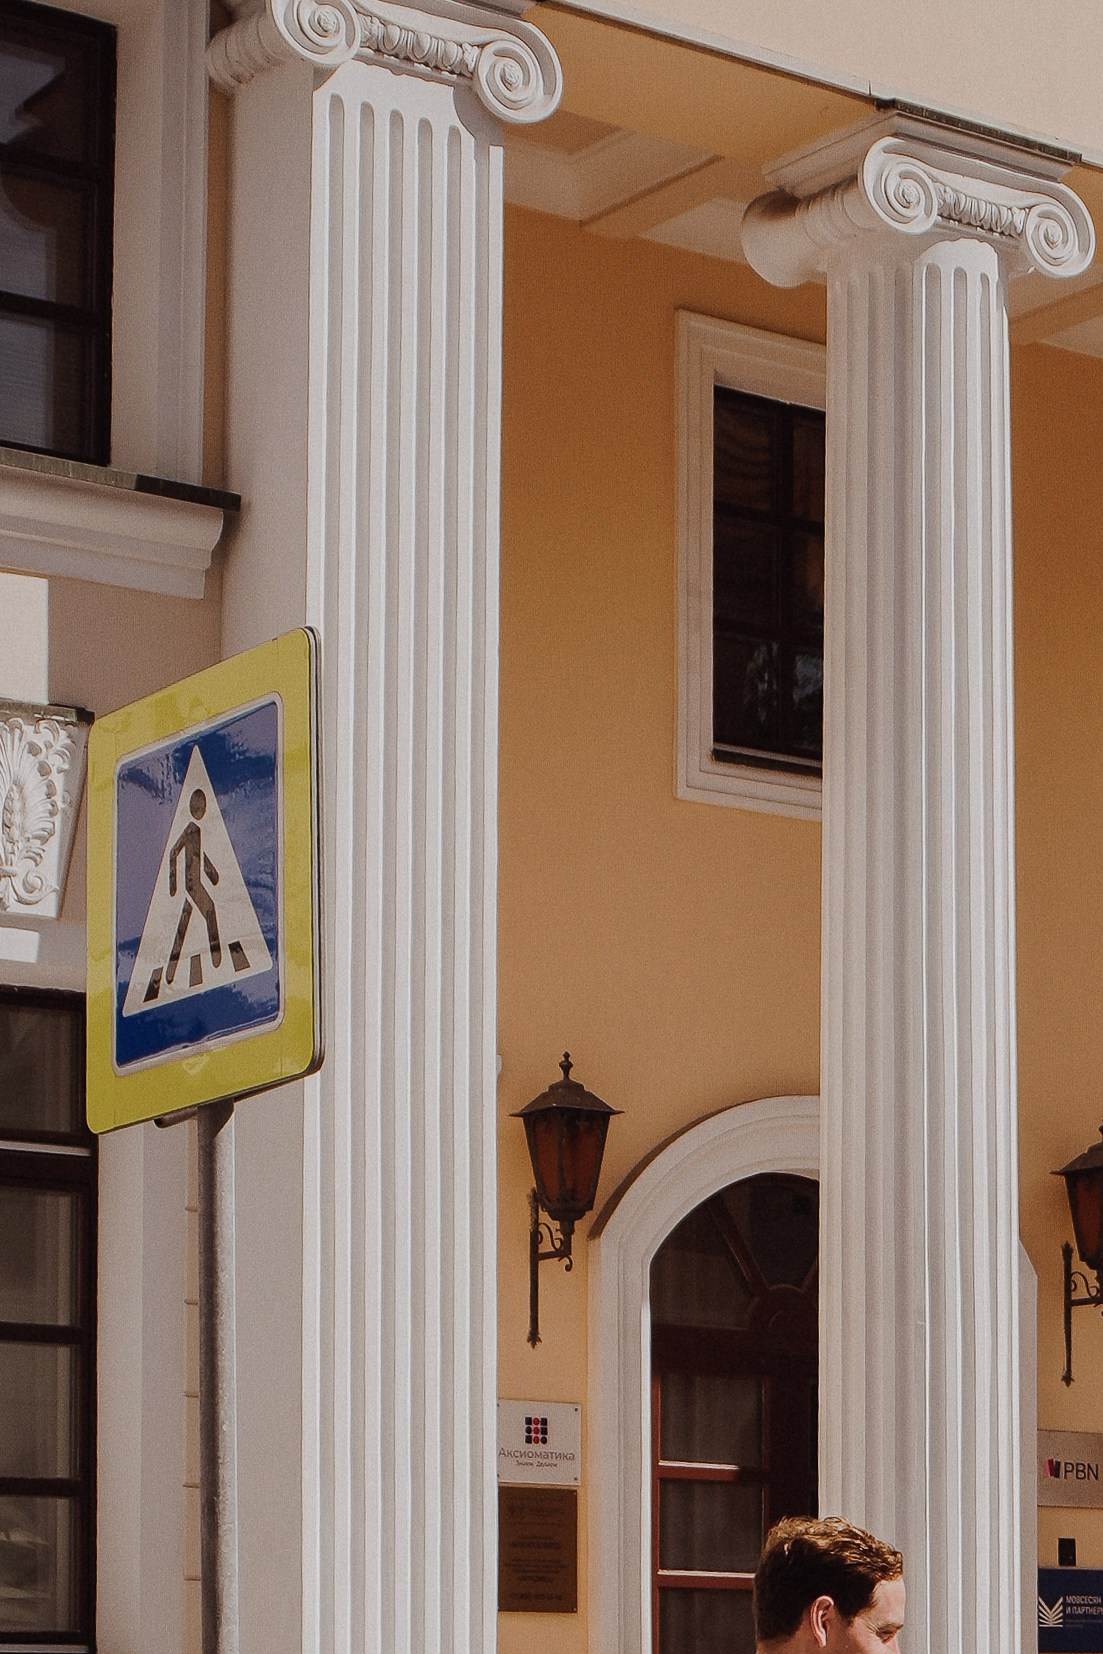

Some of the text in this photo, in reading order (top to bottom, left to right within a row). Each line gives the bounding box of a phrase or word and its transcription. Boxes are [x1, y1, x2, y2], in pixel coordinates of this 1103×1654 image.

[498, 1447, 575, 1461] Аксиоматика
[1064, 1462, 1099, 1481] PBN
[1065, 1595, 1102, 1605] МОВСЕСЯН
